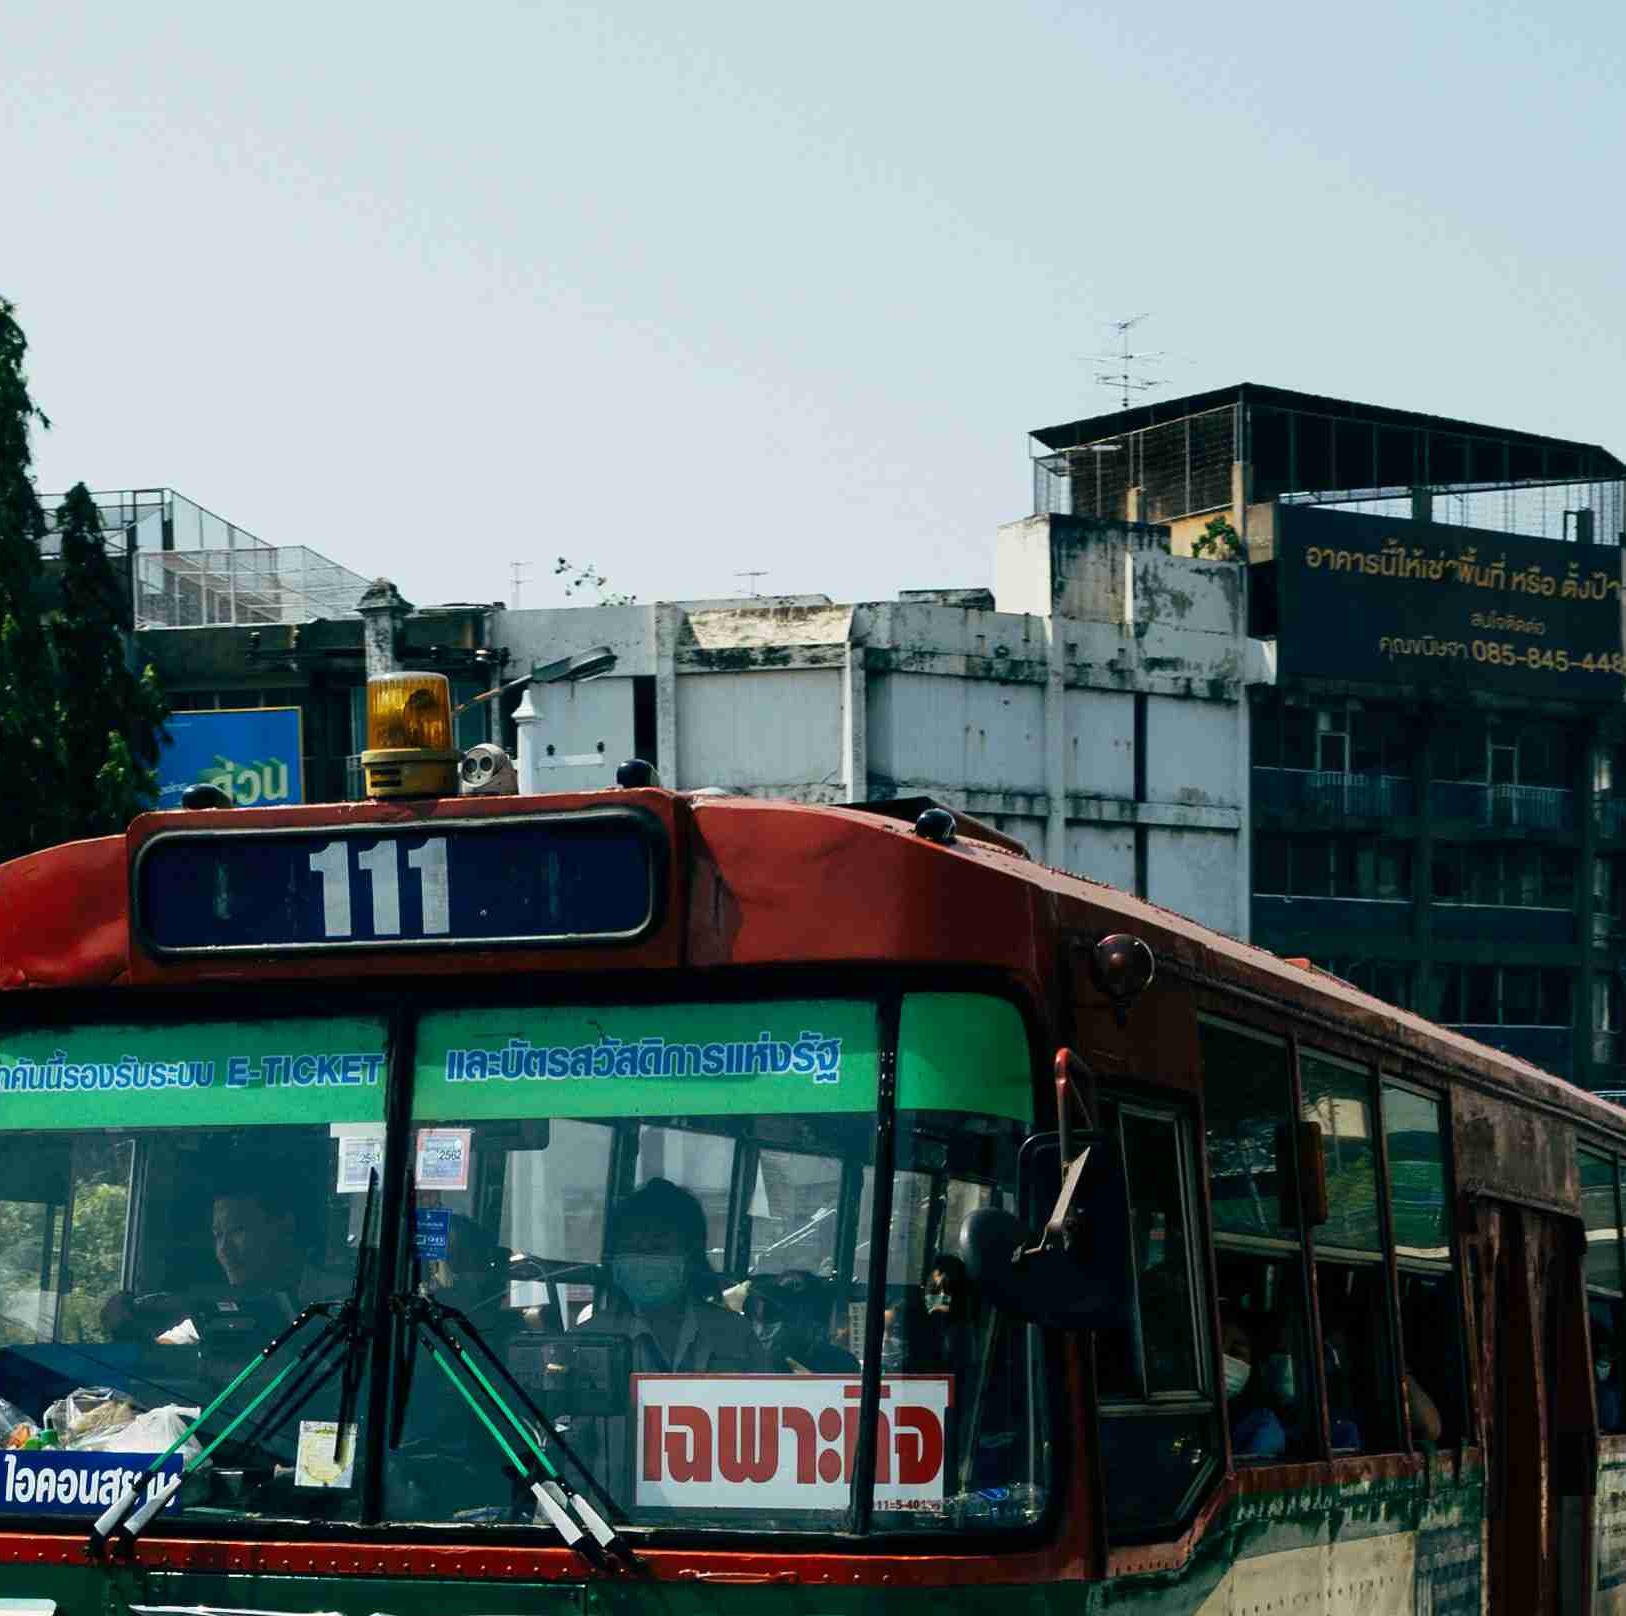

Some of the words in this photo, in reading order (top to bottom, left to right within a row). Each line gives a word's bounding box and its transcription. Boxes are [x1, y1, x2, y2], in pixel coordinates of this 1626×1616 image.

[1511, 566, 1556, 597] หรือ
[309, 837, 450, 937] 111
[226, 1053, 385, 1089] E-TICKET
[445, 1031, 843, 1085] และบัตรสวัสดิการแห่งรัฐ
